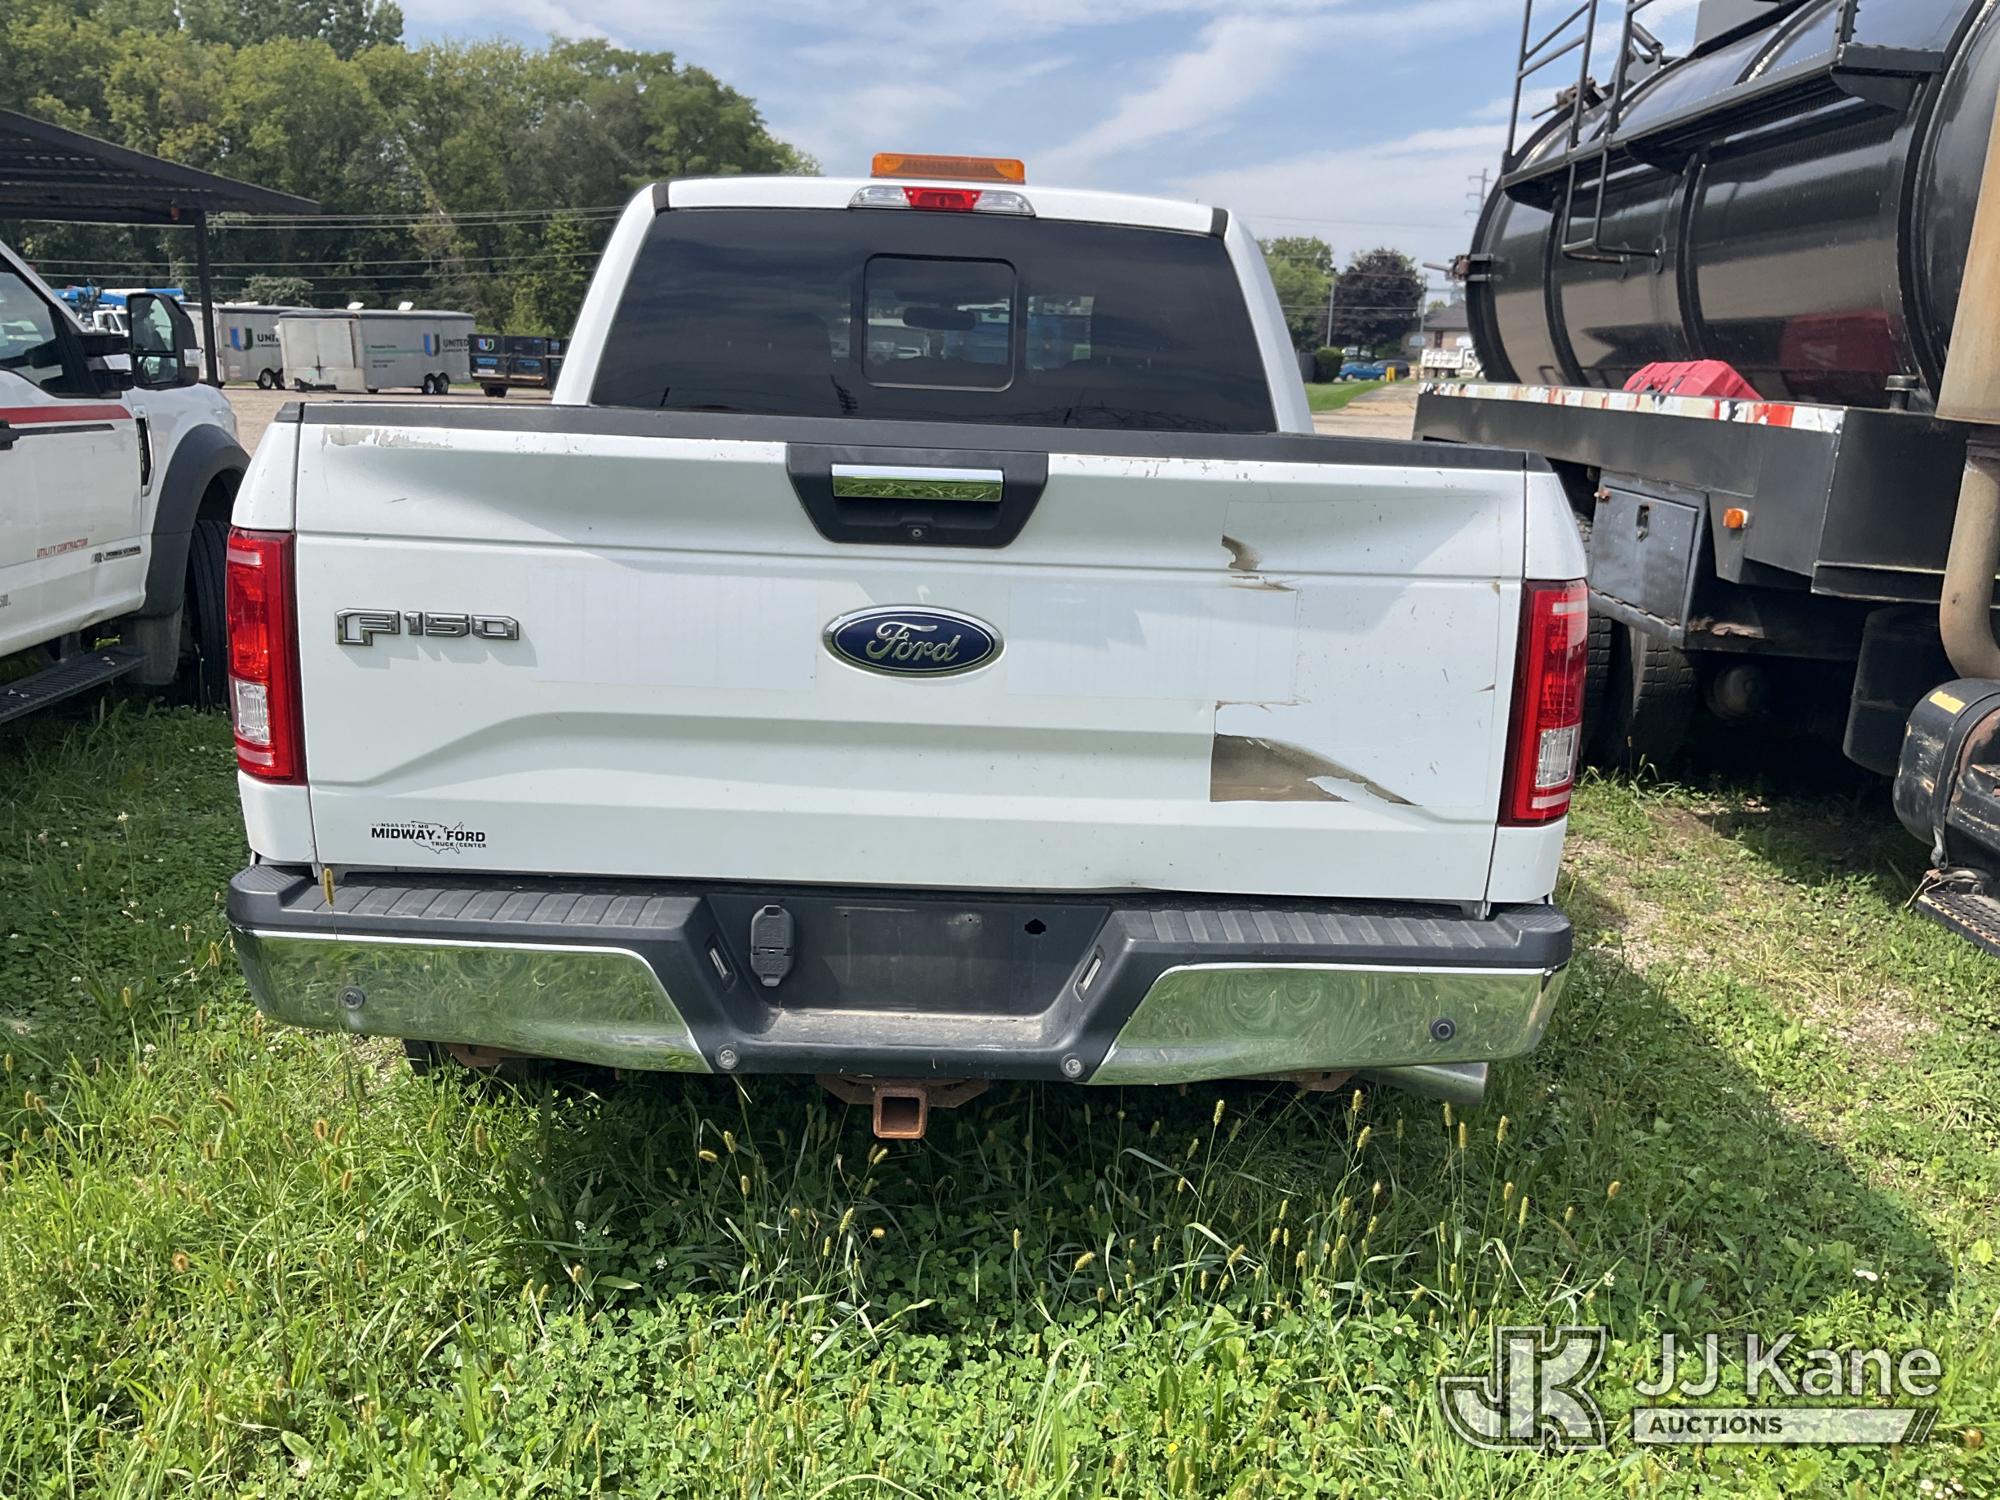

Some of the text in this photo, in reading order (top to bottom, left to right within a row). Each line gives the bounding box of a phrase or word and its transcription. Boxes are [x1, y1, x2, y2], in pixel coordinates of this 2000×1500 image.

[443, 339, 469, 348] UNITED
[866, 621, 962, 662] Ford
[371, 828, 485, 842] MIDWAY FORD
